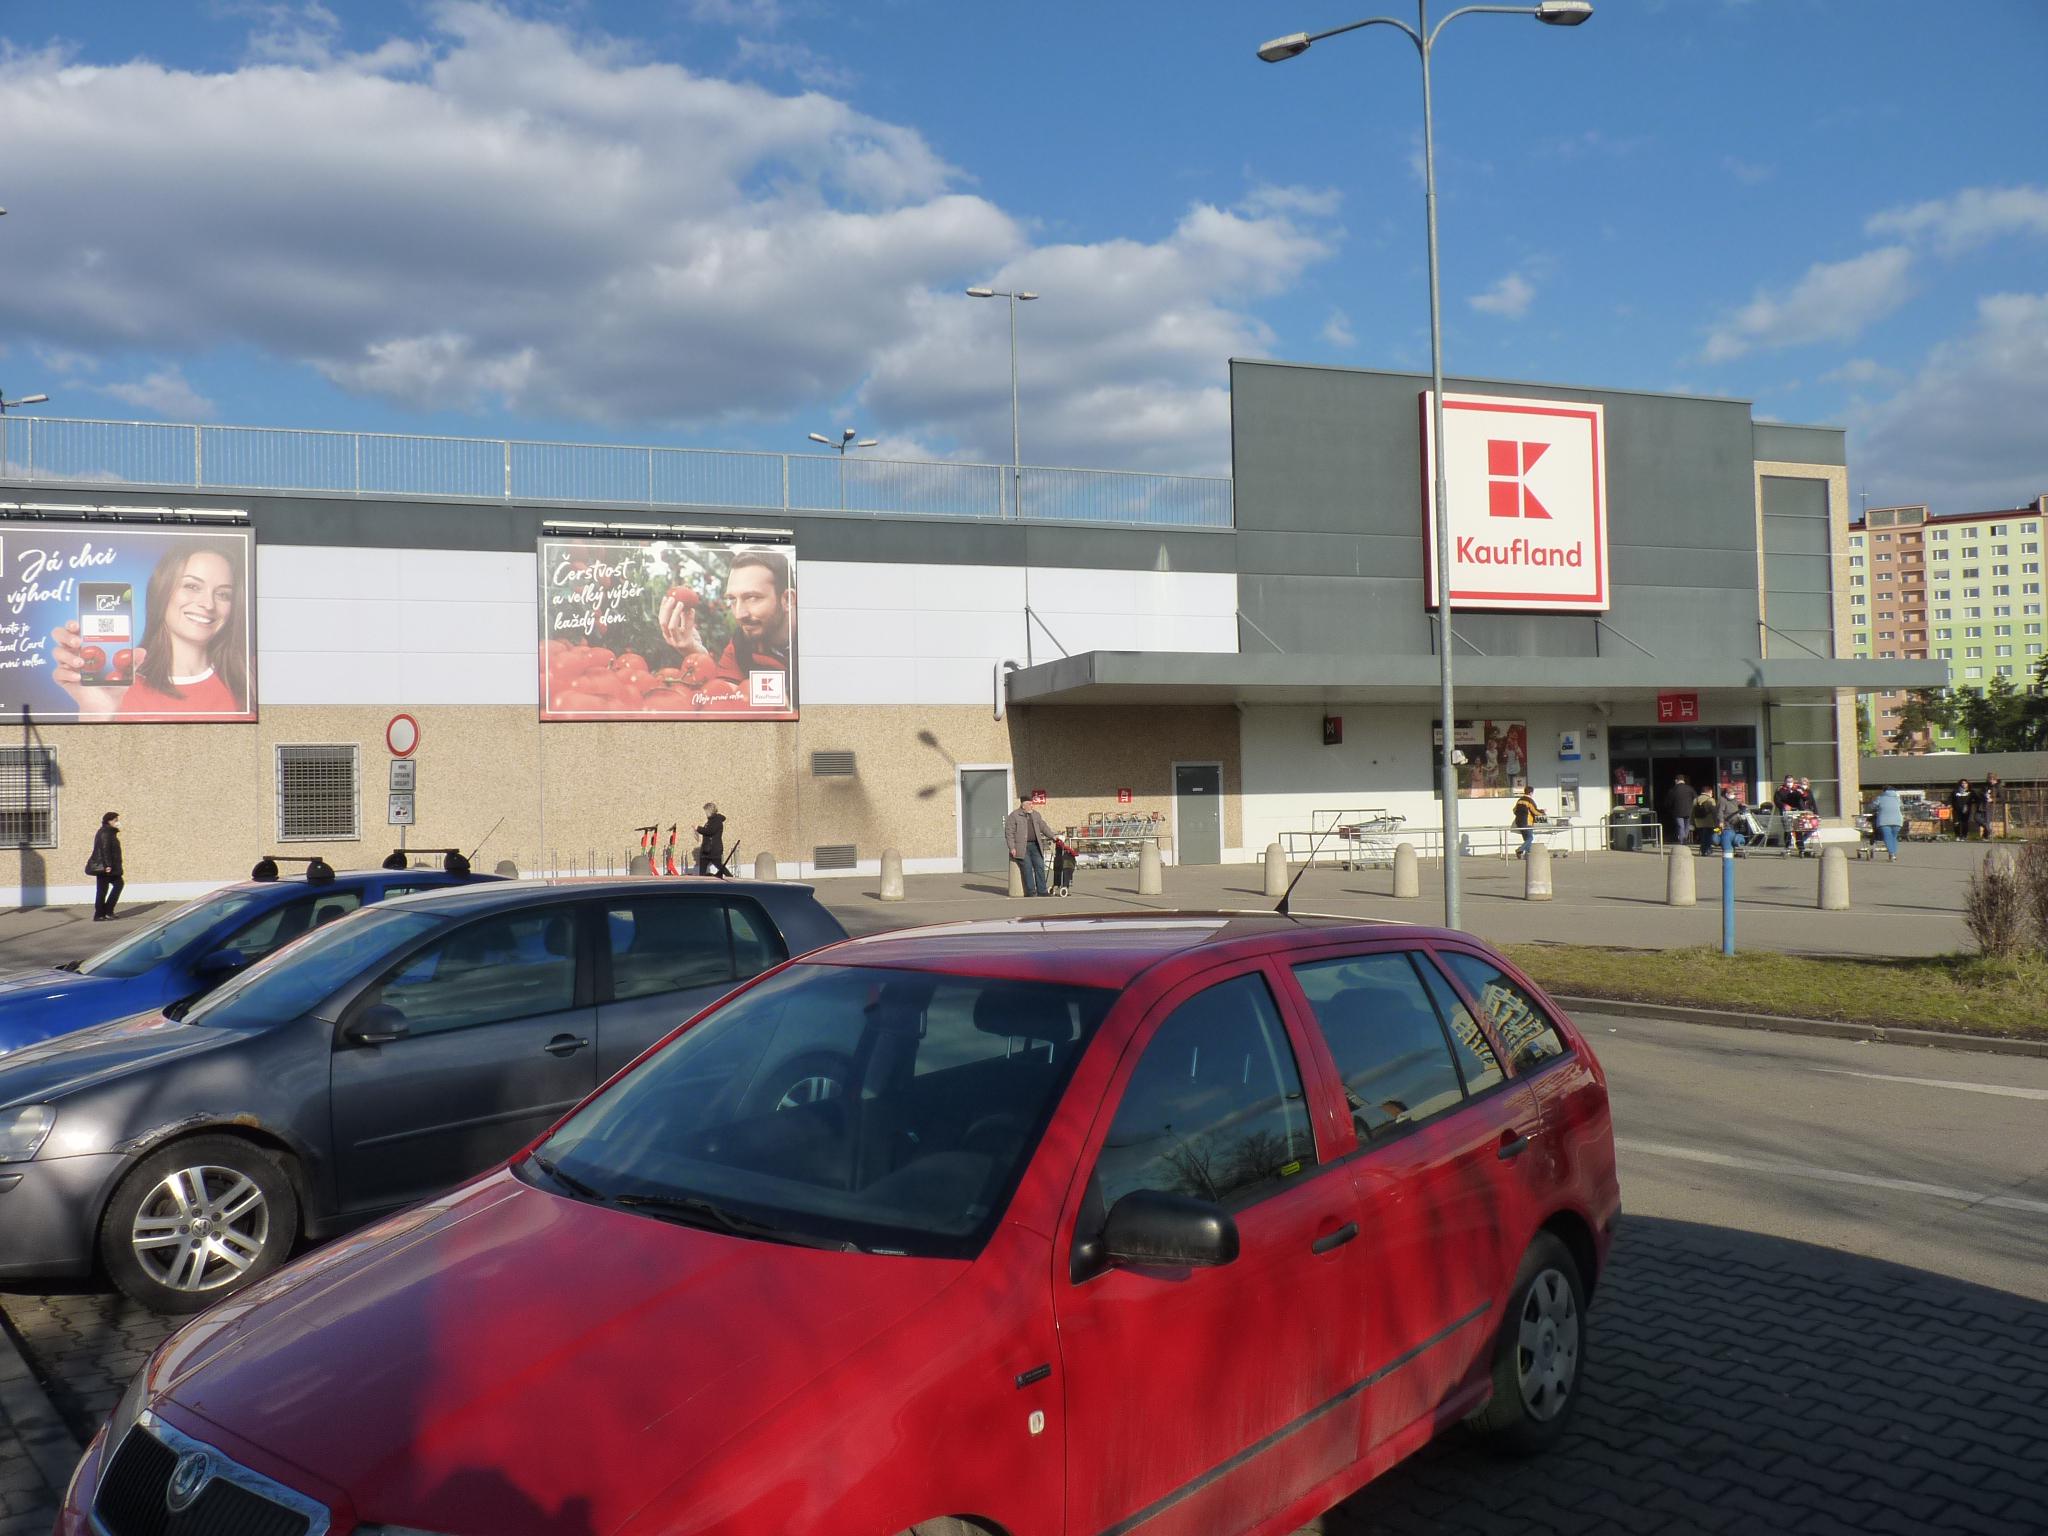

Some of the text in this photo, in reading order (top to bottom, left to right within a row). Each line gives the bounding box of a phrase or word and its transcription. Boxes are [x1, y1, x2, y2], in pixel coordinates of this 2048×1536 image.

[18, 542, 116, 583] Já chci
[1456, 535, 1582, 567] Kaufland
[552, 553, 636, 585] Čerstvost
[7, 577, 75, 614] výhod!
[552, 580, 645, 610] a velký výběr
[554, 608, 627, 635] každý den.
[20, 636, 46, 652] Card
